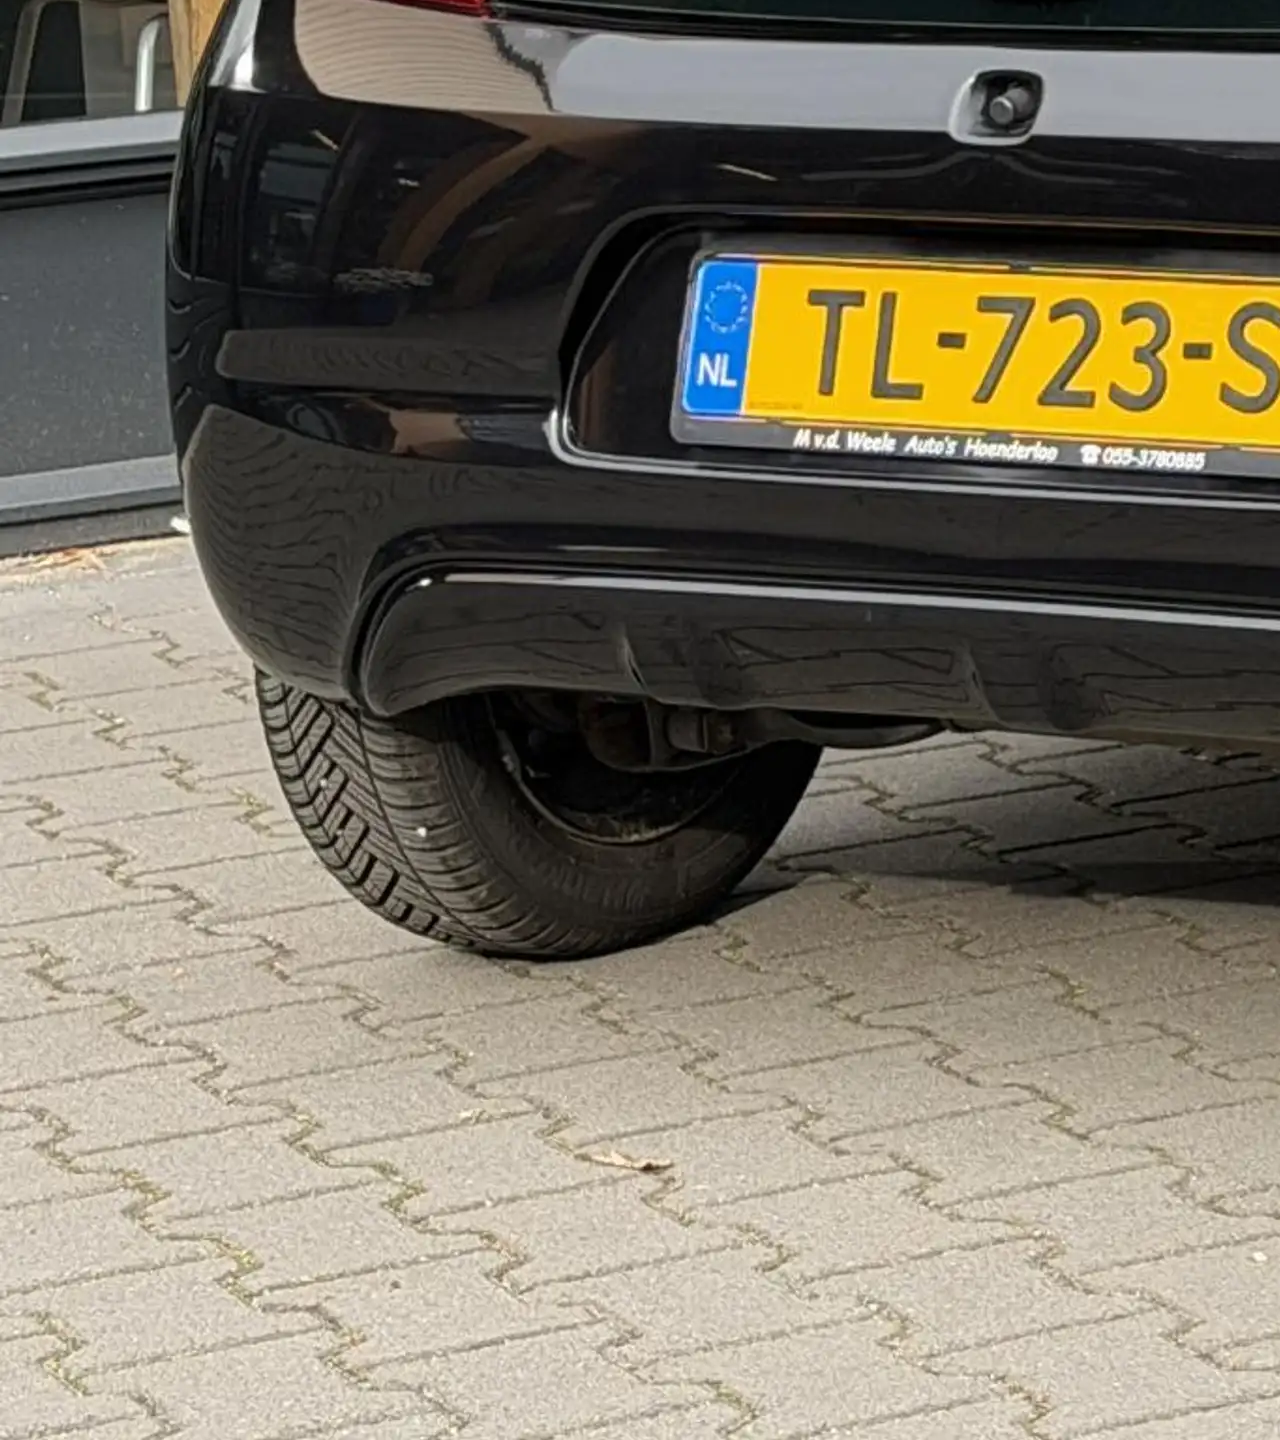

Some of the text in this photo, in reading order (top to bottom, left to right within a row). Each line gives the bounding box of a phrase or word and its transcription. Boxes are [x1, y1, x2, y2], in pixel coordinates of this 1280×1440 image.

[697, 354, 737, 388] NL
[904, 435, 958, 457] Auto's
[964, 440, 1059, 463] Hoenderloo
